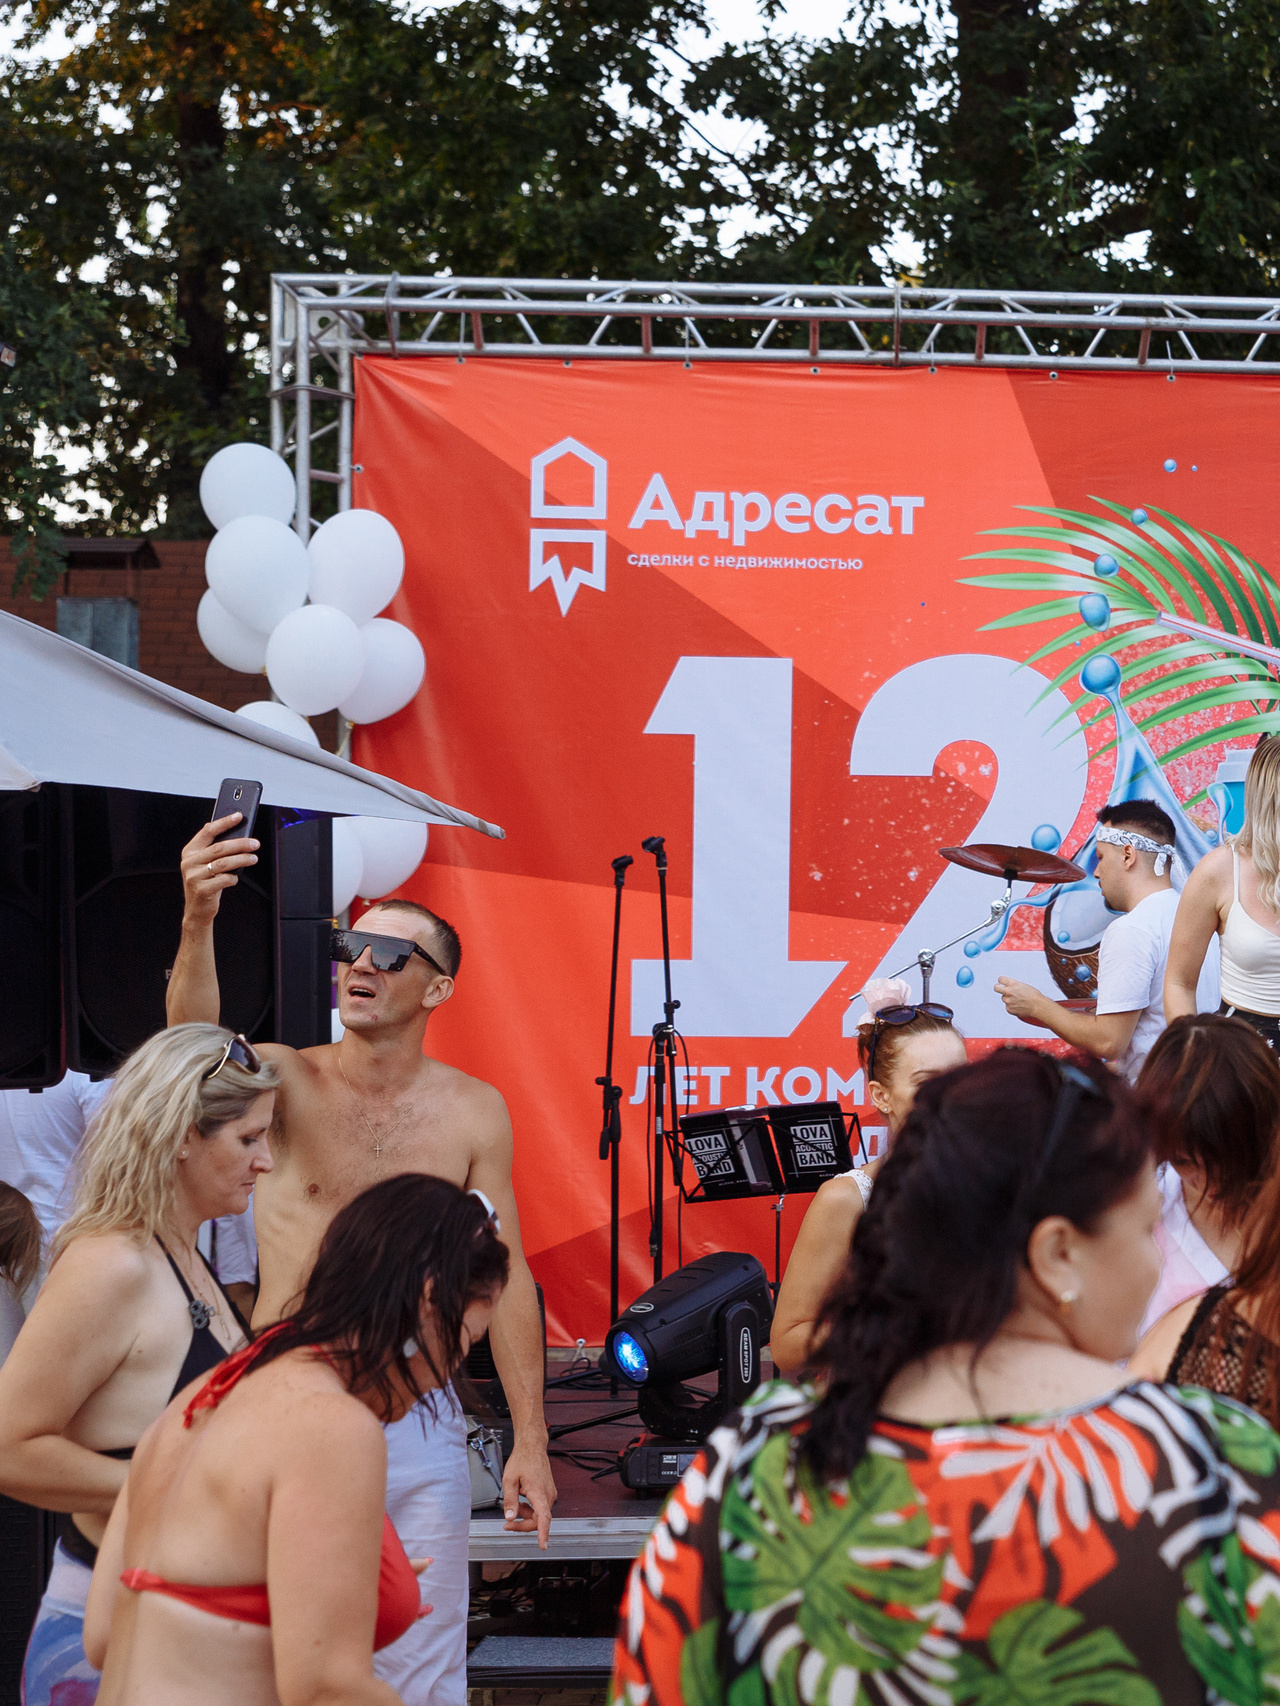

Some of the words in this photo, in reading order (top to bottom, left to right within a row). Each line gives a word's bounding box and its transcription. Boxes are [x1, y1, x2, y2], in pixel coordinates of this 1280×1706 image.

[627, 473, 925, 547] Адресат
[627, 553, 694, 568] сделки
[698, 556, 709, 568] с
[714, 555, 863, 570] недвижимостью
[630, 653, 1090, 1038] 12
[629, 1066, 731, 1105] ЛЕТ
[746, 1066, 875, 1105] КОМ
[792, 1125, 829, 1140] LOVA
[686, 1136, 724, 1152] LOVA
[798, 1151, 835, 1166] BAND
[695, 1159, 733, 1178] BND
